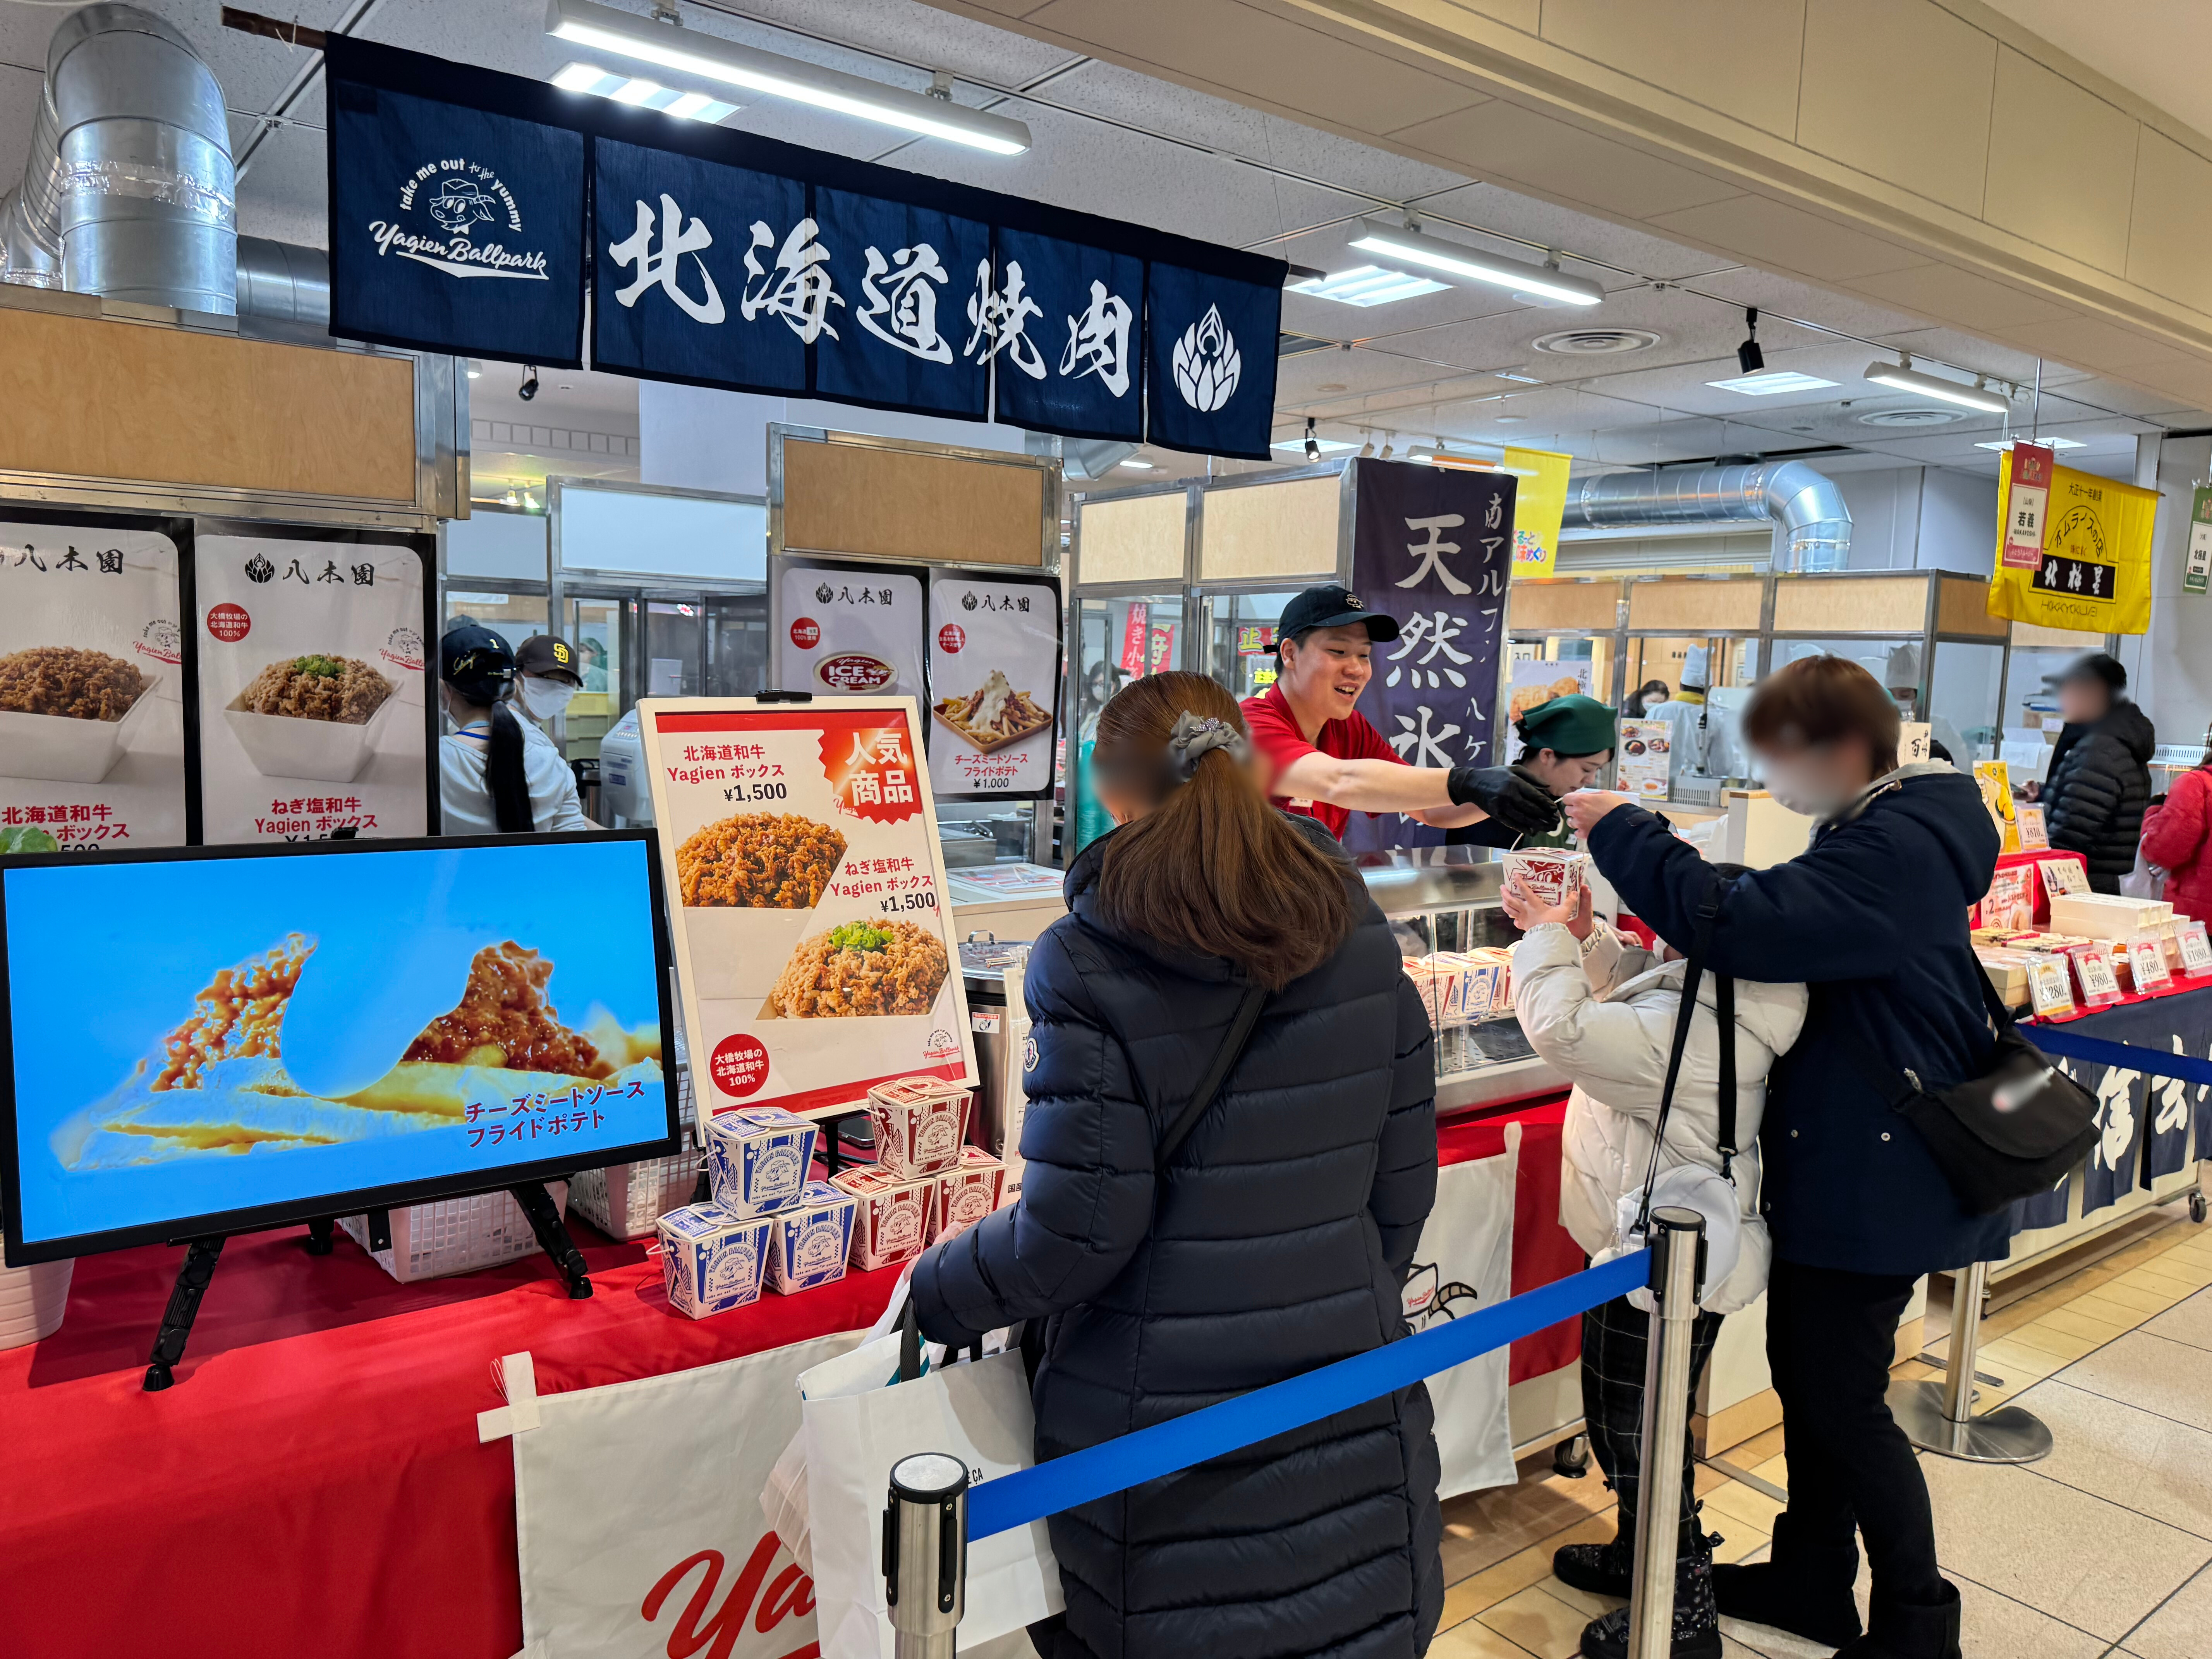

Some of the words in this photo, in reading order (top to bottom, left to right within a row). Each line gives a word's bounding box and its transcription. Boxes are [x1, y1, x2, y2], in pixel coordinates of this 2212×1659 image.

[400, 179, 417, 211] take
[416, 163, 437, 181] me
[441, 158, 465, 171] out
[491, 179, 522, 232] yummy
[369, 221, 448, 256] Yagien
[447, 238, 547, 271] Ballpark
[609, 193, 1132, 397] 北海道焼肉
[2055, 513, 2104, 557] オムライスの店
[14, 544, 124, 574] 八木園
[282, 558, 374, 586] 八木園
[2045, 559, 2103, 595] 北極星
[837, 586, 893, 607] 八木園
[981, 594, 1030, 613] 八木園
[554, 643, 569, 663] SD
[828, 666, 864, 677] ICE
[684, 744, 766, 762] 北海道和牛
[845, 732, 908, 766] 人気
[954, 753, 1029, 766] チーズミートソース
[667, 765, 726, 784] Yagien
[730, 763, 785, 779] ボックス
[963, 765, 1019, 777] フライドポテト
[724, 782, 787, 802] ¥1,500
[851, 770, 914, 807] 商品
[2, 804, 113, 825] 北海道和牛
[272, 797, 362, 815] ねぎ塩和牛
[57, 823, 130, 842] ボックス
[255, 818, 310, 834] Yagien
[316, 815, 378, 831] ボックス
[845, 858, 914, 876] ねぎ塩和牛
[830, 880, 883, 898] Yagien
[886, 876, 934, 891] ボックス
[881, 892, 935, 913] ¥1,500
[2089, 972, 2109, 988] ¥980
[714, 1048, 763, 1066] 大橋牧場の
[716, 1060, 765, 1077] 北海道和牛
[729, 1073, 756, 1087] 100%
[466, 1081, 646, 1124] チーズミートソース
[467, 1108, 605, 1148] フライドポテト
